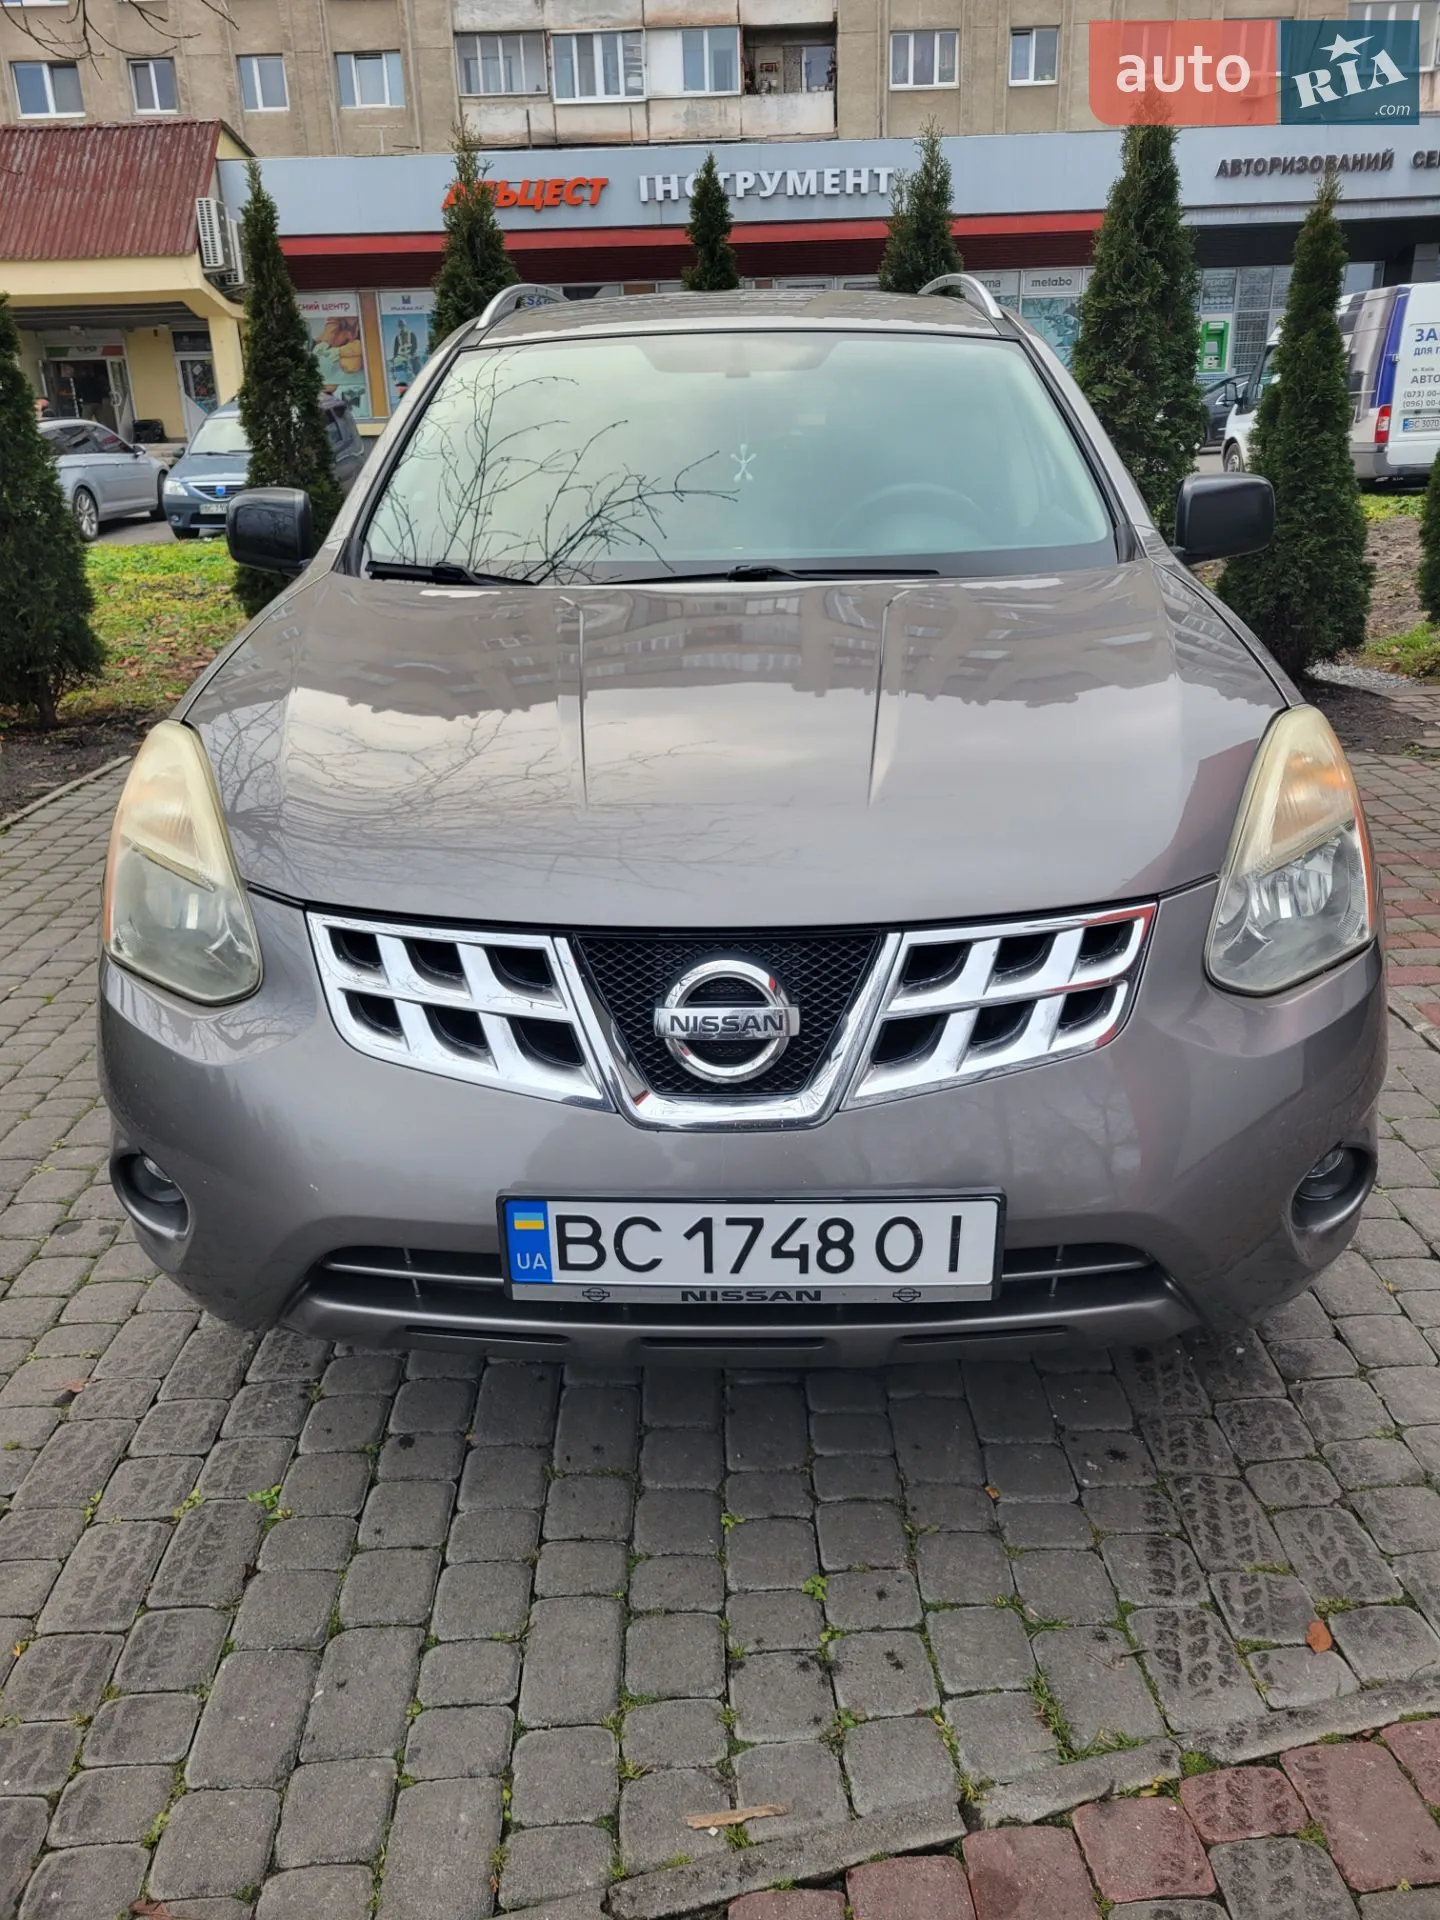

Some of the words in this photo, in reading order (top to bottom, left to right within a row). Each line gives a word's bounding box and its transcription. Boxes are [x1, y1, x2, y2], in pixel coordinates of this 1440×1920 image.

[1215, 148, 1395, 178] АВТОРИЗОВАНИЙ
[1411, 150, 1440, 170] СЕ
[1031, 277, 1073, 288] metabo
[1415, 328, 1440, 342] ЗА
[669, 1014, 784, 1033] NISSAN
[555, 1214, 663, 1273] BC
[682, 1216, 855, 1275] 1748
[516, 1252, 548, 1270] UA
[681, 1290, 822, 1302] NISSAN
